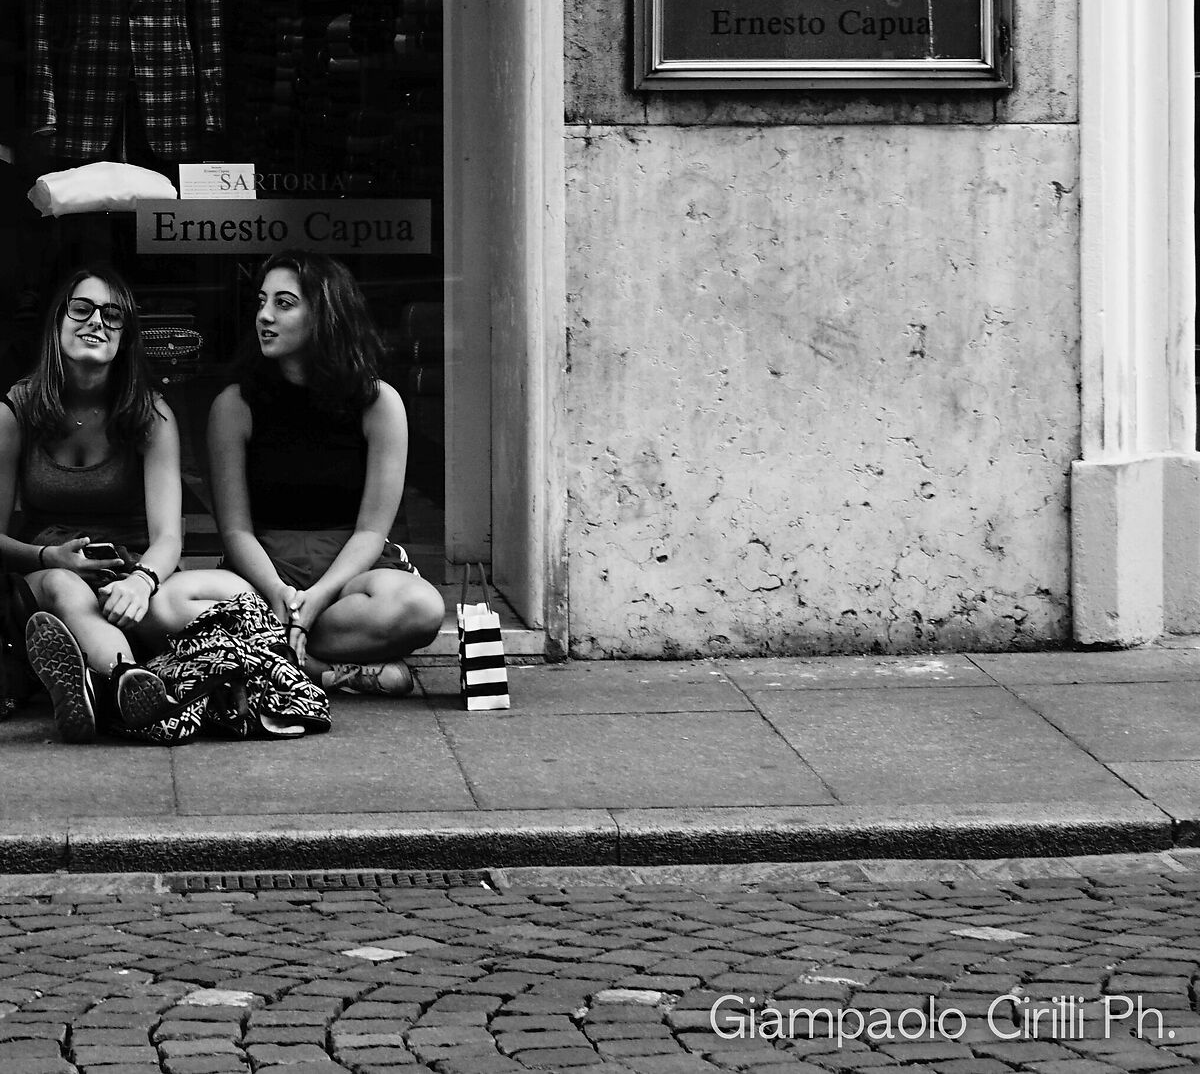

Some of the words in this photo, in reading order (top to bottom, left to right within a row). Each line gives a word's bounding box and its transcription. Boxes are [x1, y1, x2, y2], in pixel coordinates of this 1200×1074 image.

[711, 10, 825, 35] Ernesto
[838, 10, 933, 40] Capua
[219, 172, 347, 191] SARTORIA
[152, 211, 288, 243] Ernesto
[304, 211, 414, 248] Capua
